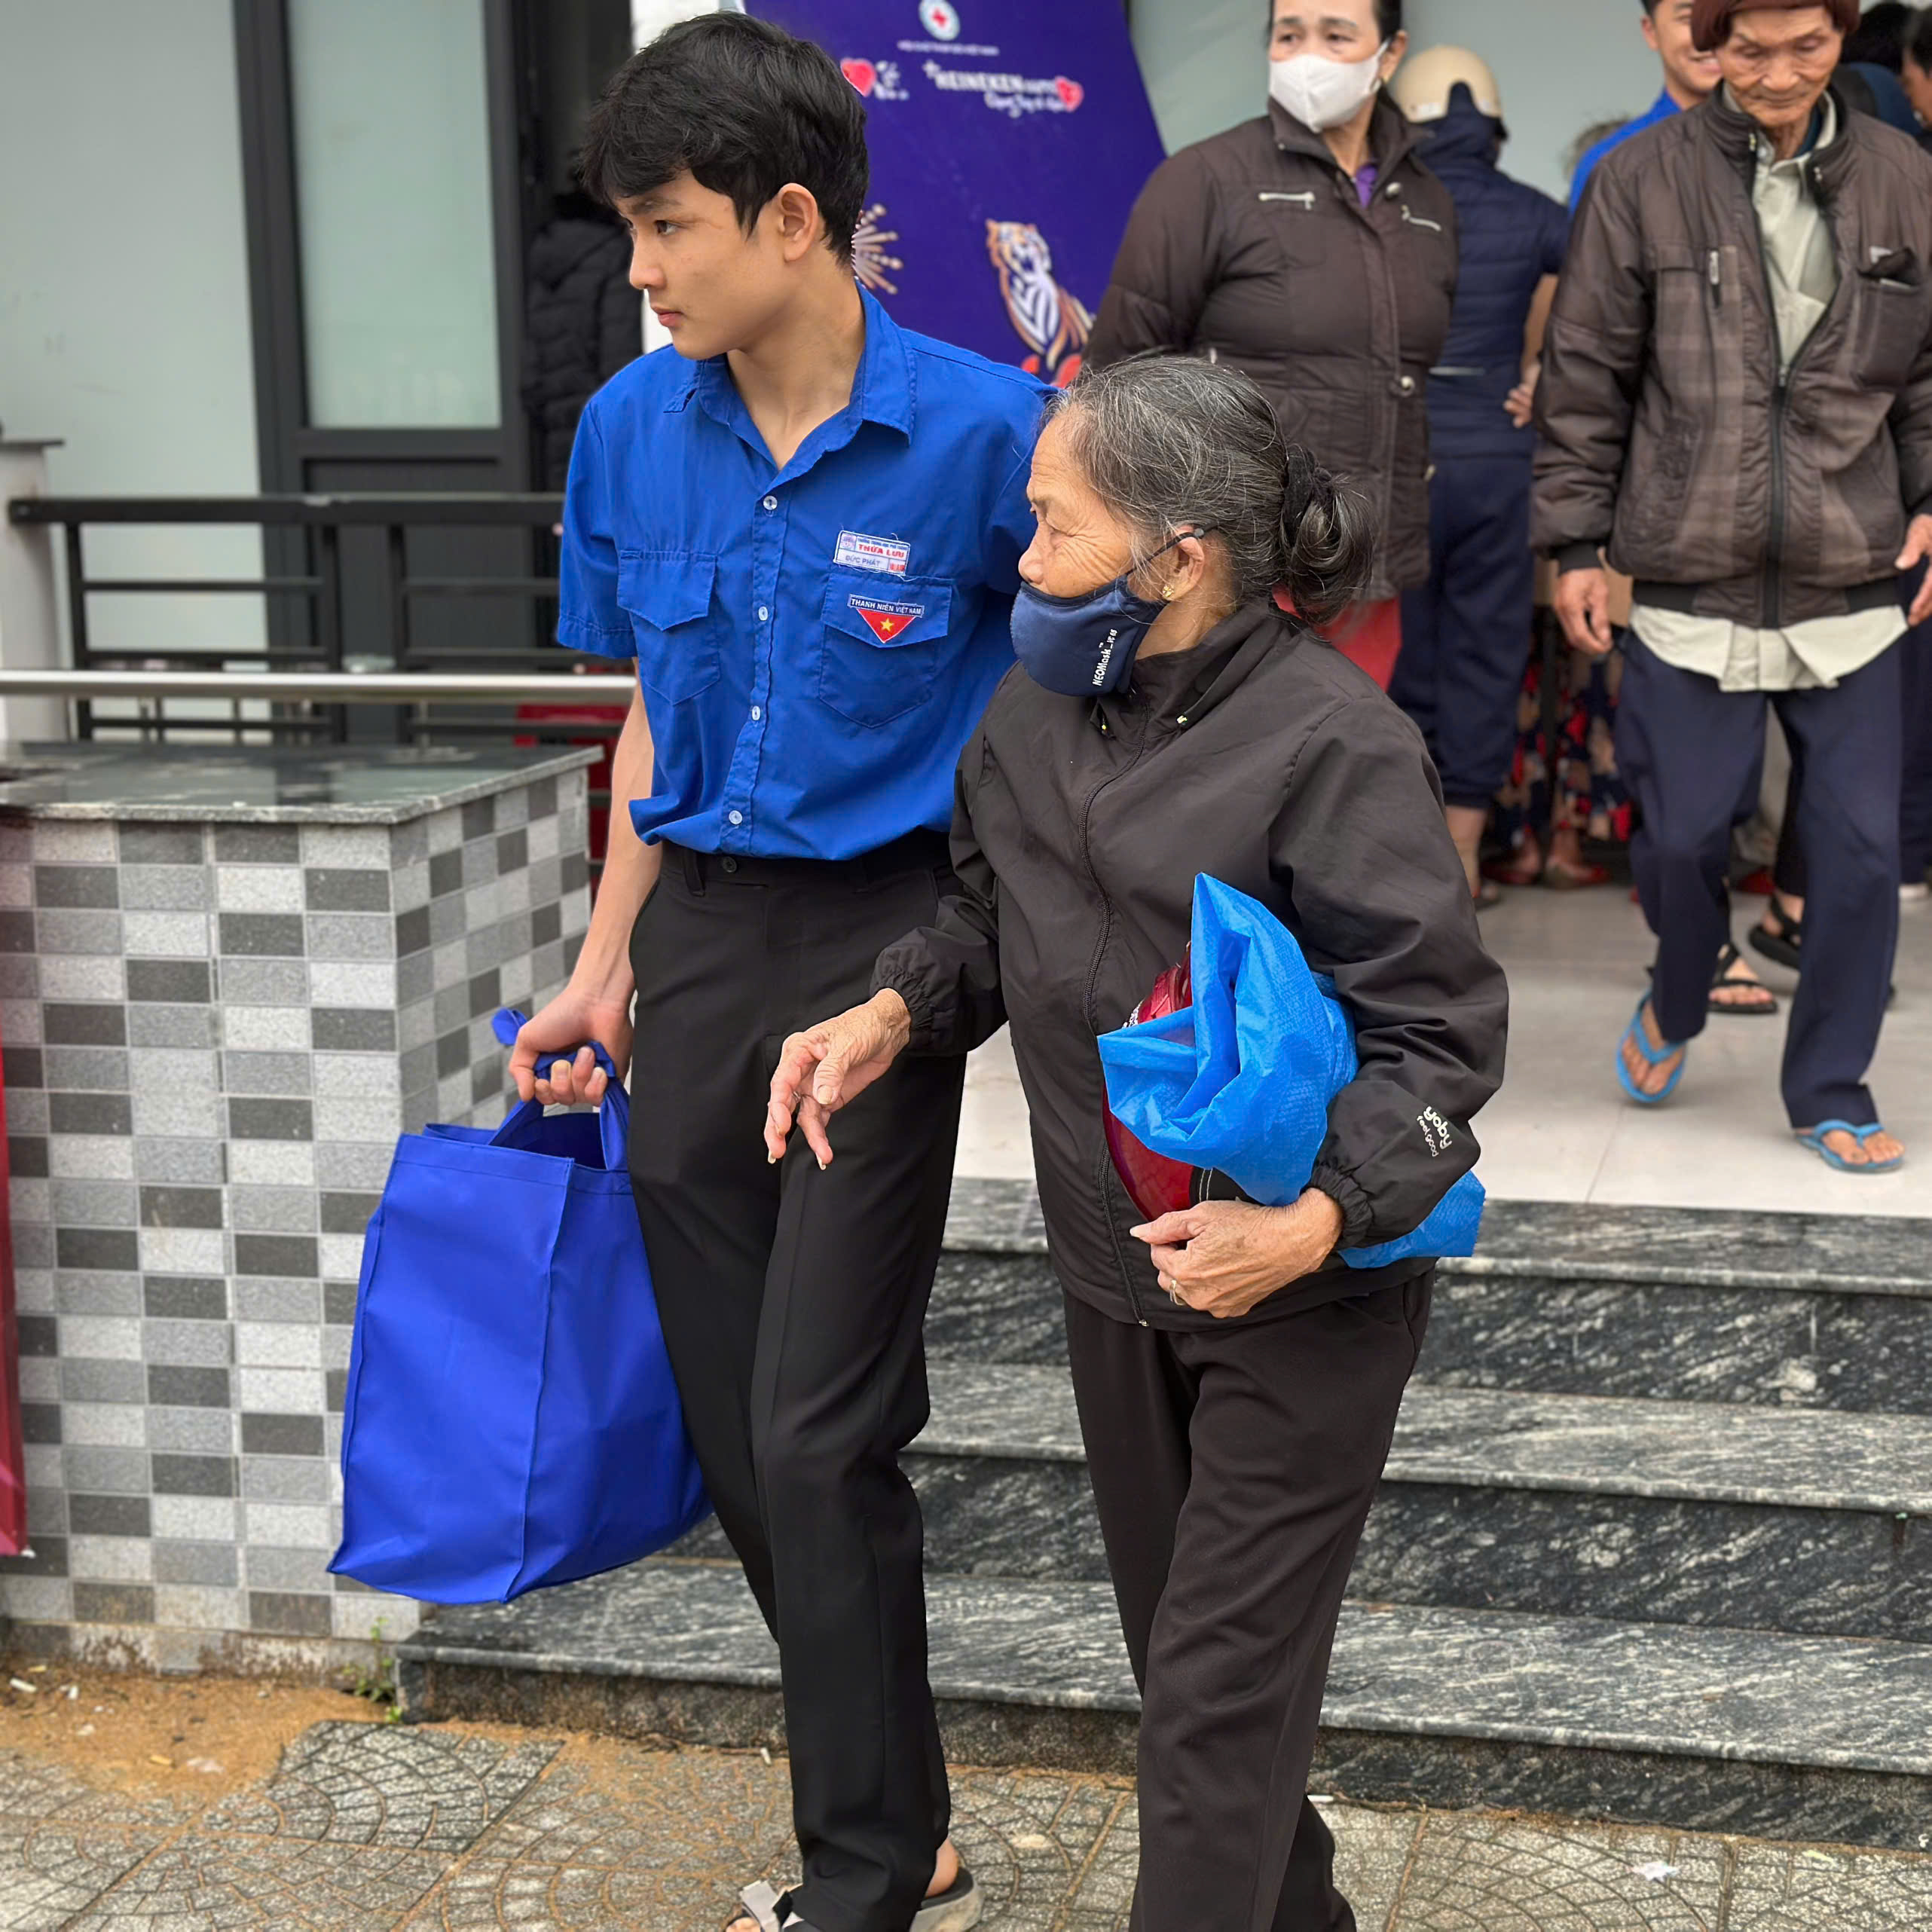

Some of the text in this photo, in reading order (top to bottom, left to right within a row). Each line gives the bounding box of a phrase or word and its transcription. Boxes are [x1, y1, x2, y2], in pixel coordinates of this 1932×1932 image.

[851, 598, 876, 609] THANH
[1423, 1106, 1452, 1149] yoby
[1425, 1133, 1439, 1157] good
